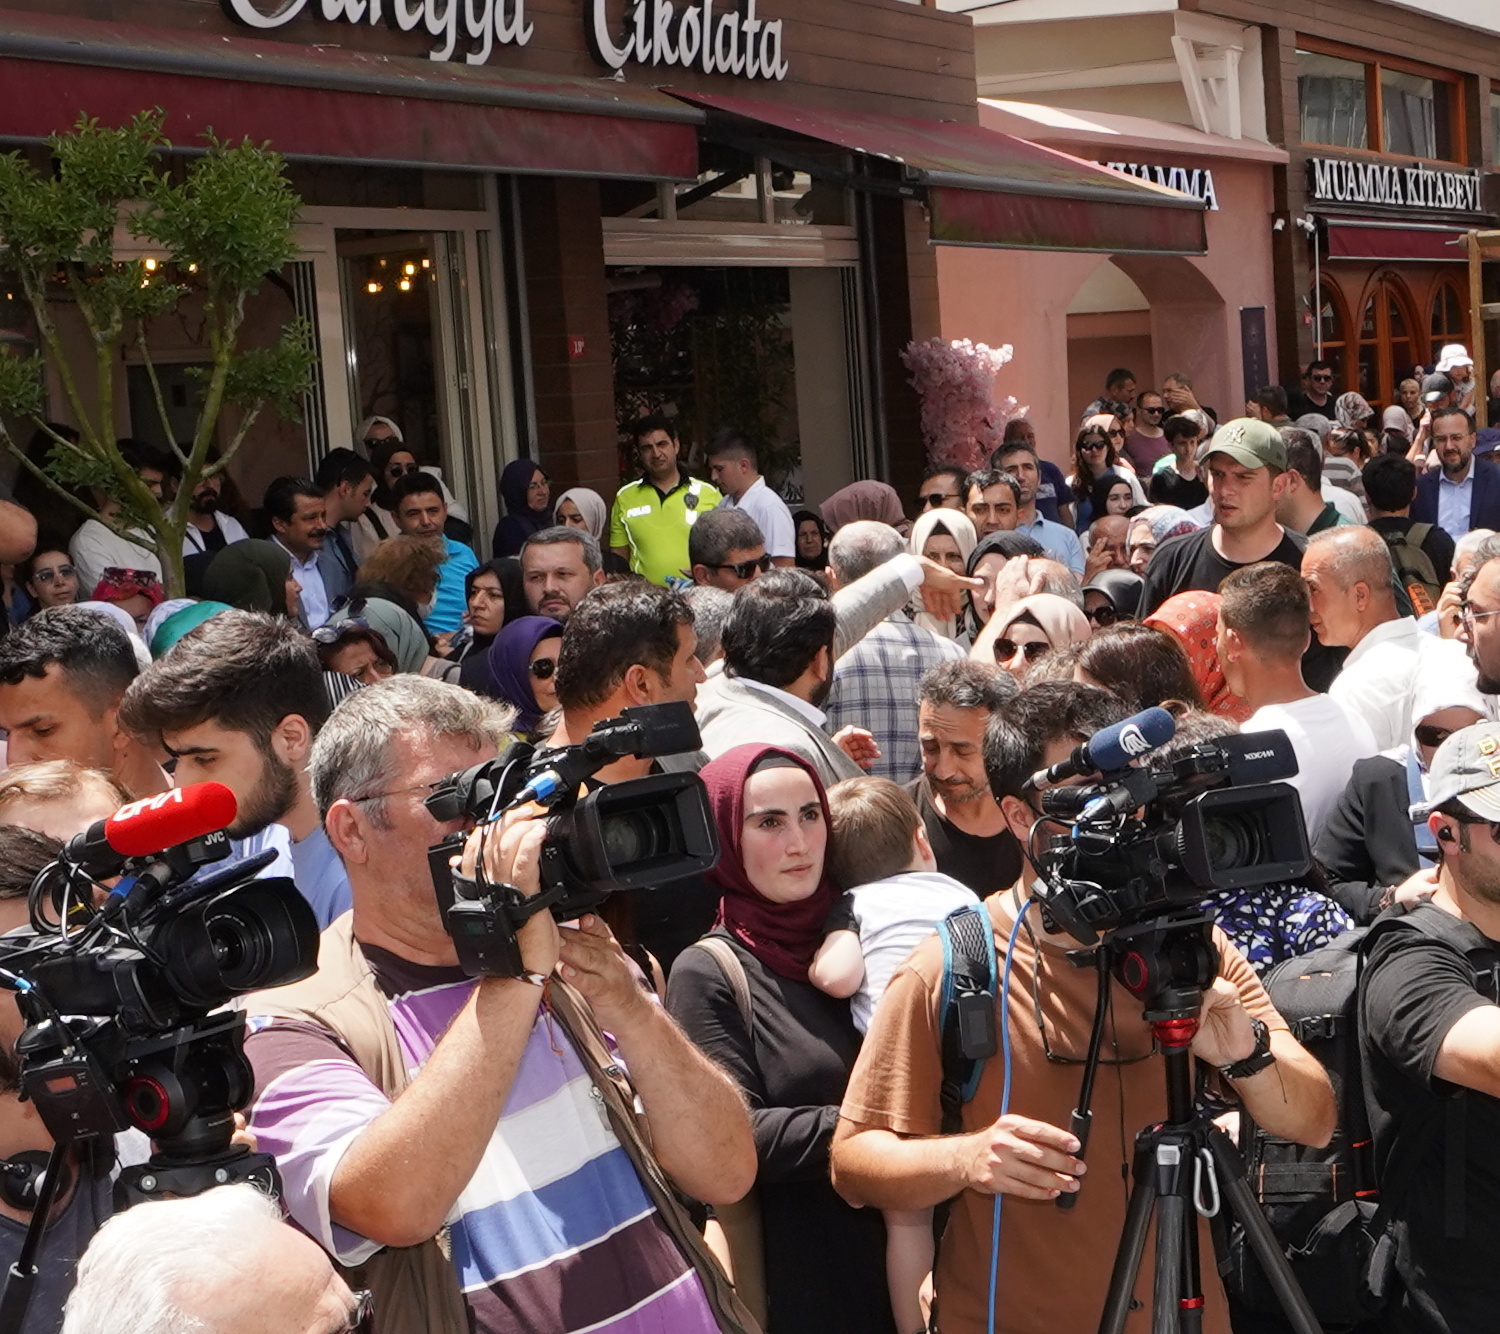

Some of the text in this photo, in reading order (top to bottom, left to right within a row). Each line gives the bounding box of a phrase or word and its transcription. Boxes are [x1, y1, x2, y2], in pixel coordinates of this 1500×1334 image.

[1313, 158, 1483, 211] MUAMMA KİTABEVİ
[204, 830, 226, 846] JVC
